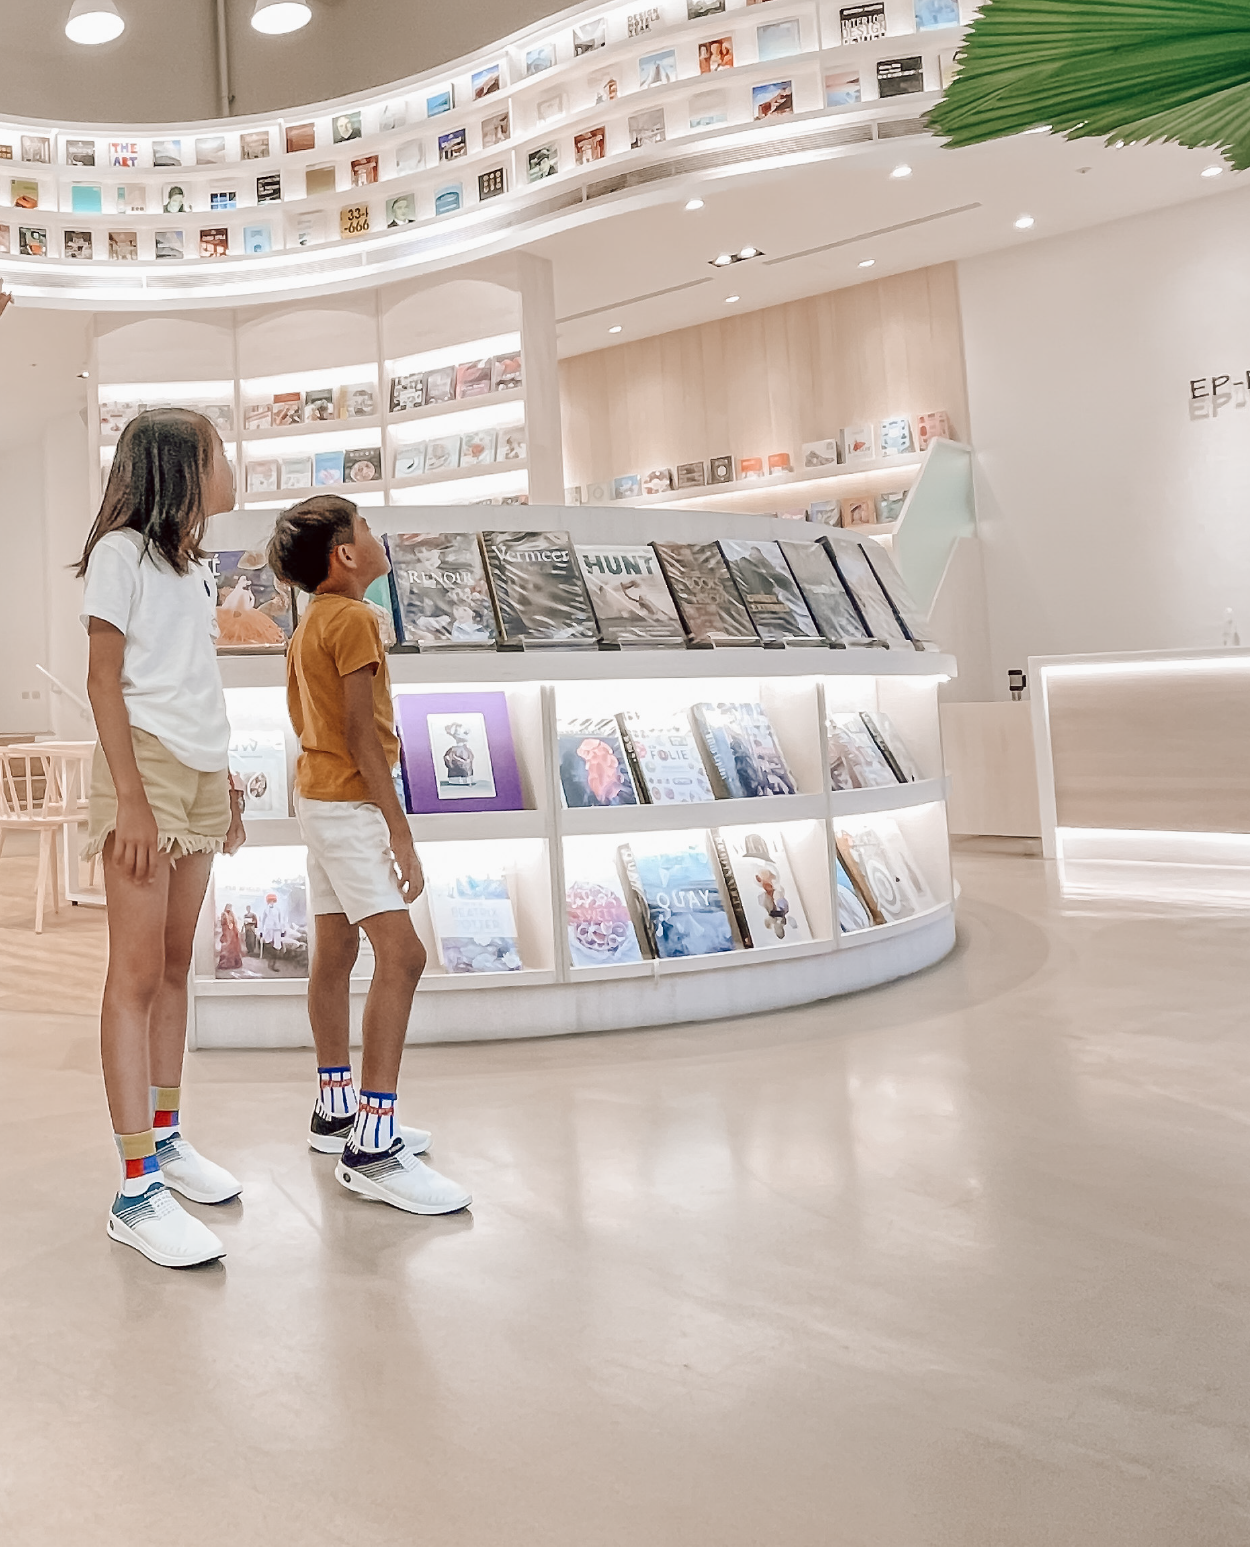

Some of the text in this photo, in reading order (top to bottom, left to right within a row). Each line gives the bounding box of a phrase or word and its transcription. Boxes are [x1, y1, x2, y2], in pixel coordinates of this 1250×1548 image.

[112, 143, 138, 154] THE
[113, 156, 138, 168] ART
[1190, 370, 1250, 399] EP-
[491, 545, 570, 562] Vermeer
[582, 554, 653, 575] HUNT
[650, 749, 689, 761] FOLIE
[655, 889, 711, 917] QUAY
